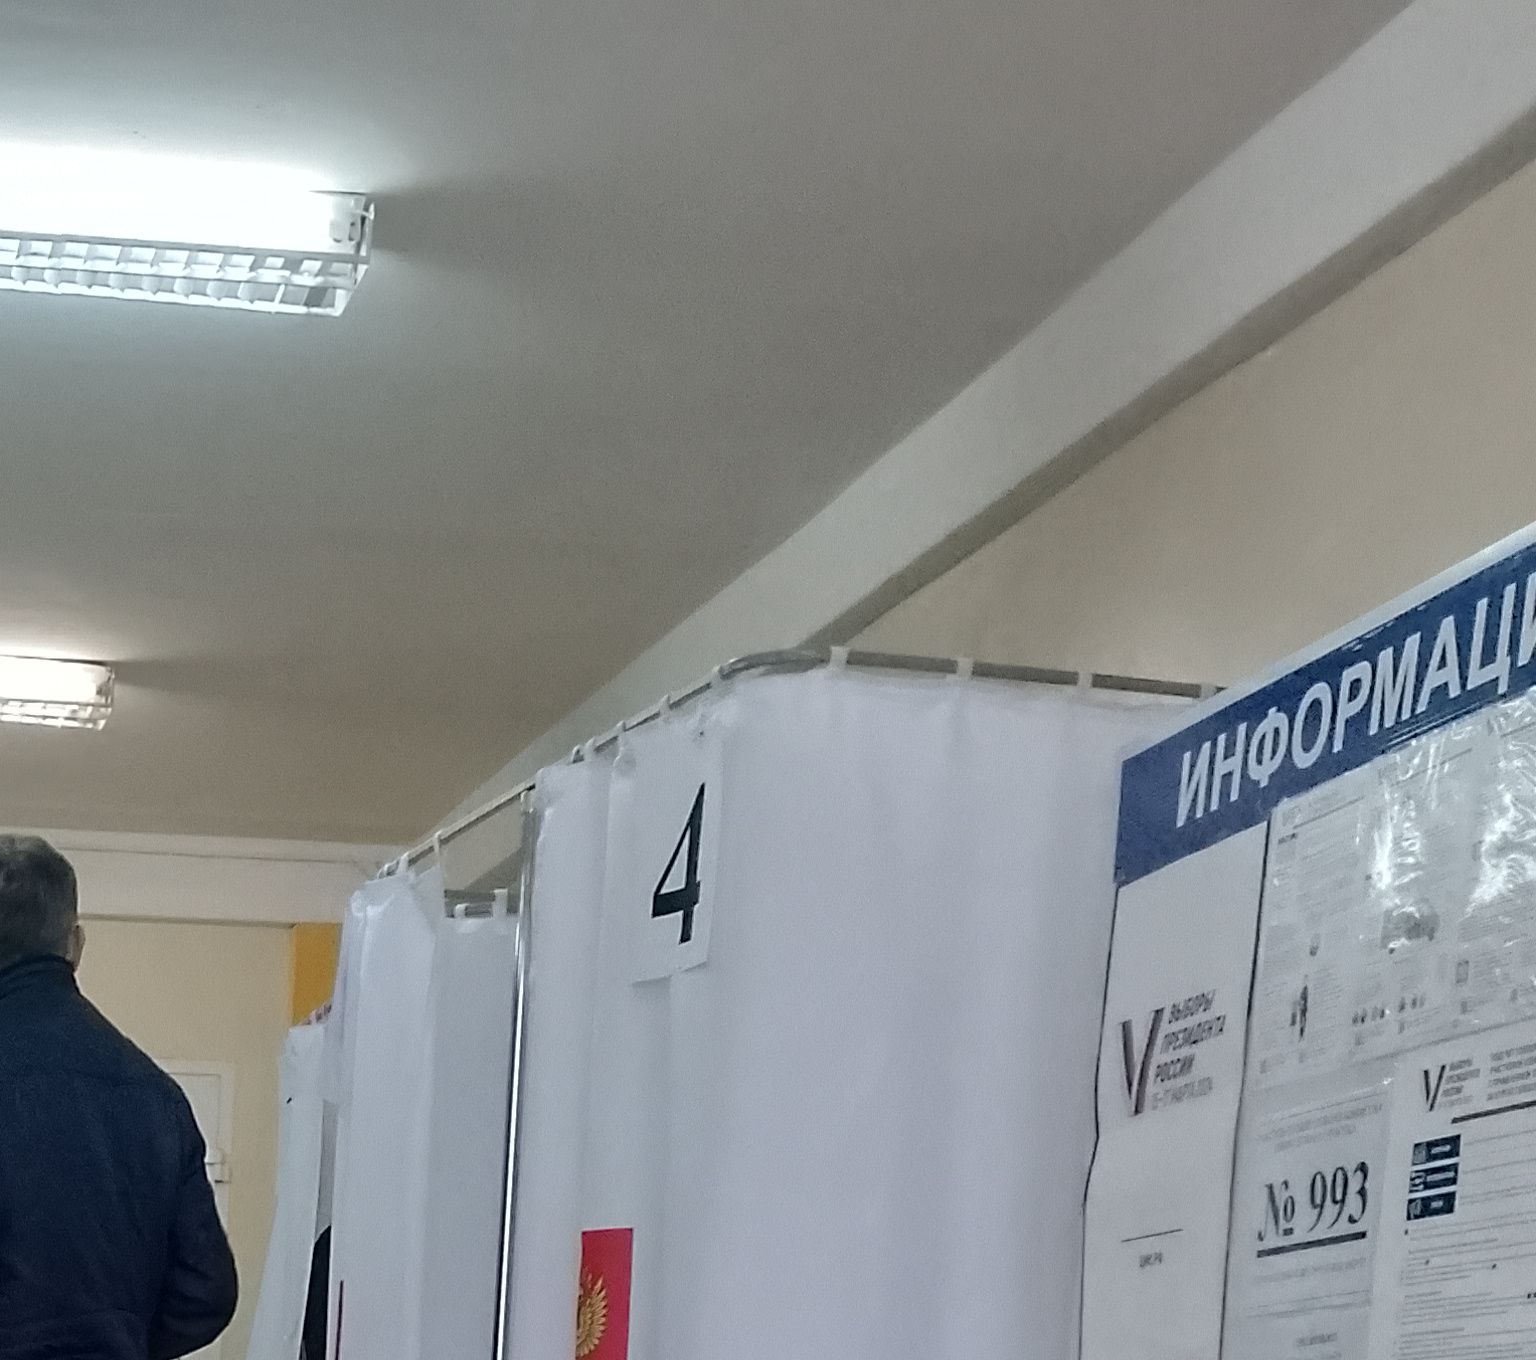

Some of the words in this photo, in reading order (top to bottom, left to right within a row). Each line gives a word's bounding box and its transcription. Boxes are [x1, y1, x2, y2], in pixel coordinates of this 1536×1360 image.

[651, 782, 705, 945] 4
[1257, 1178, 1296, 1238] №
[1306, 1160, 1369, 1234] 993
